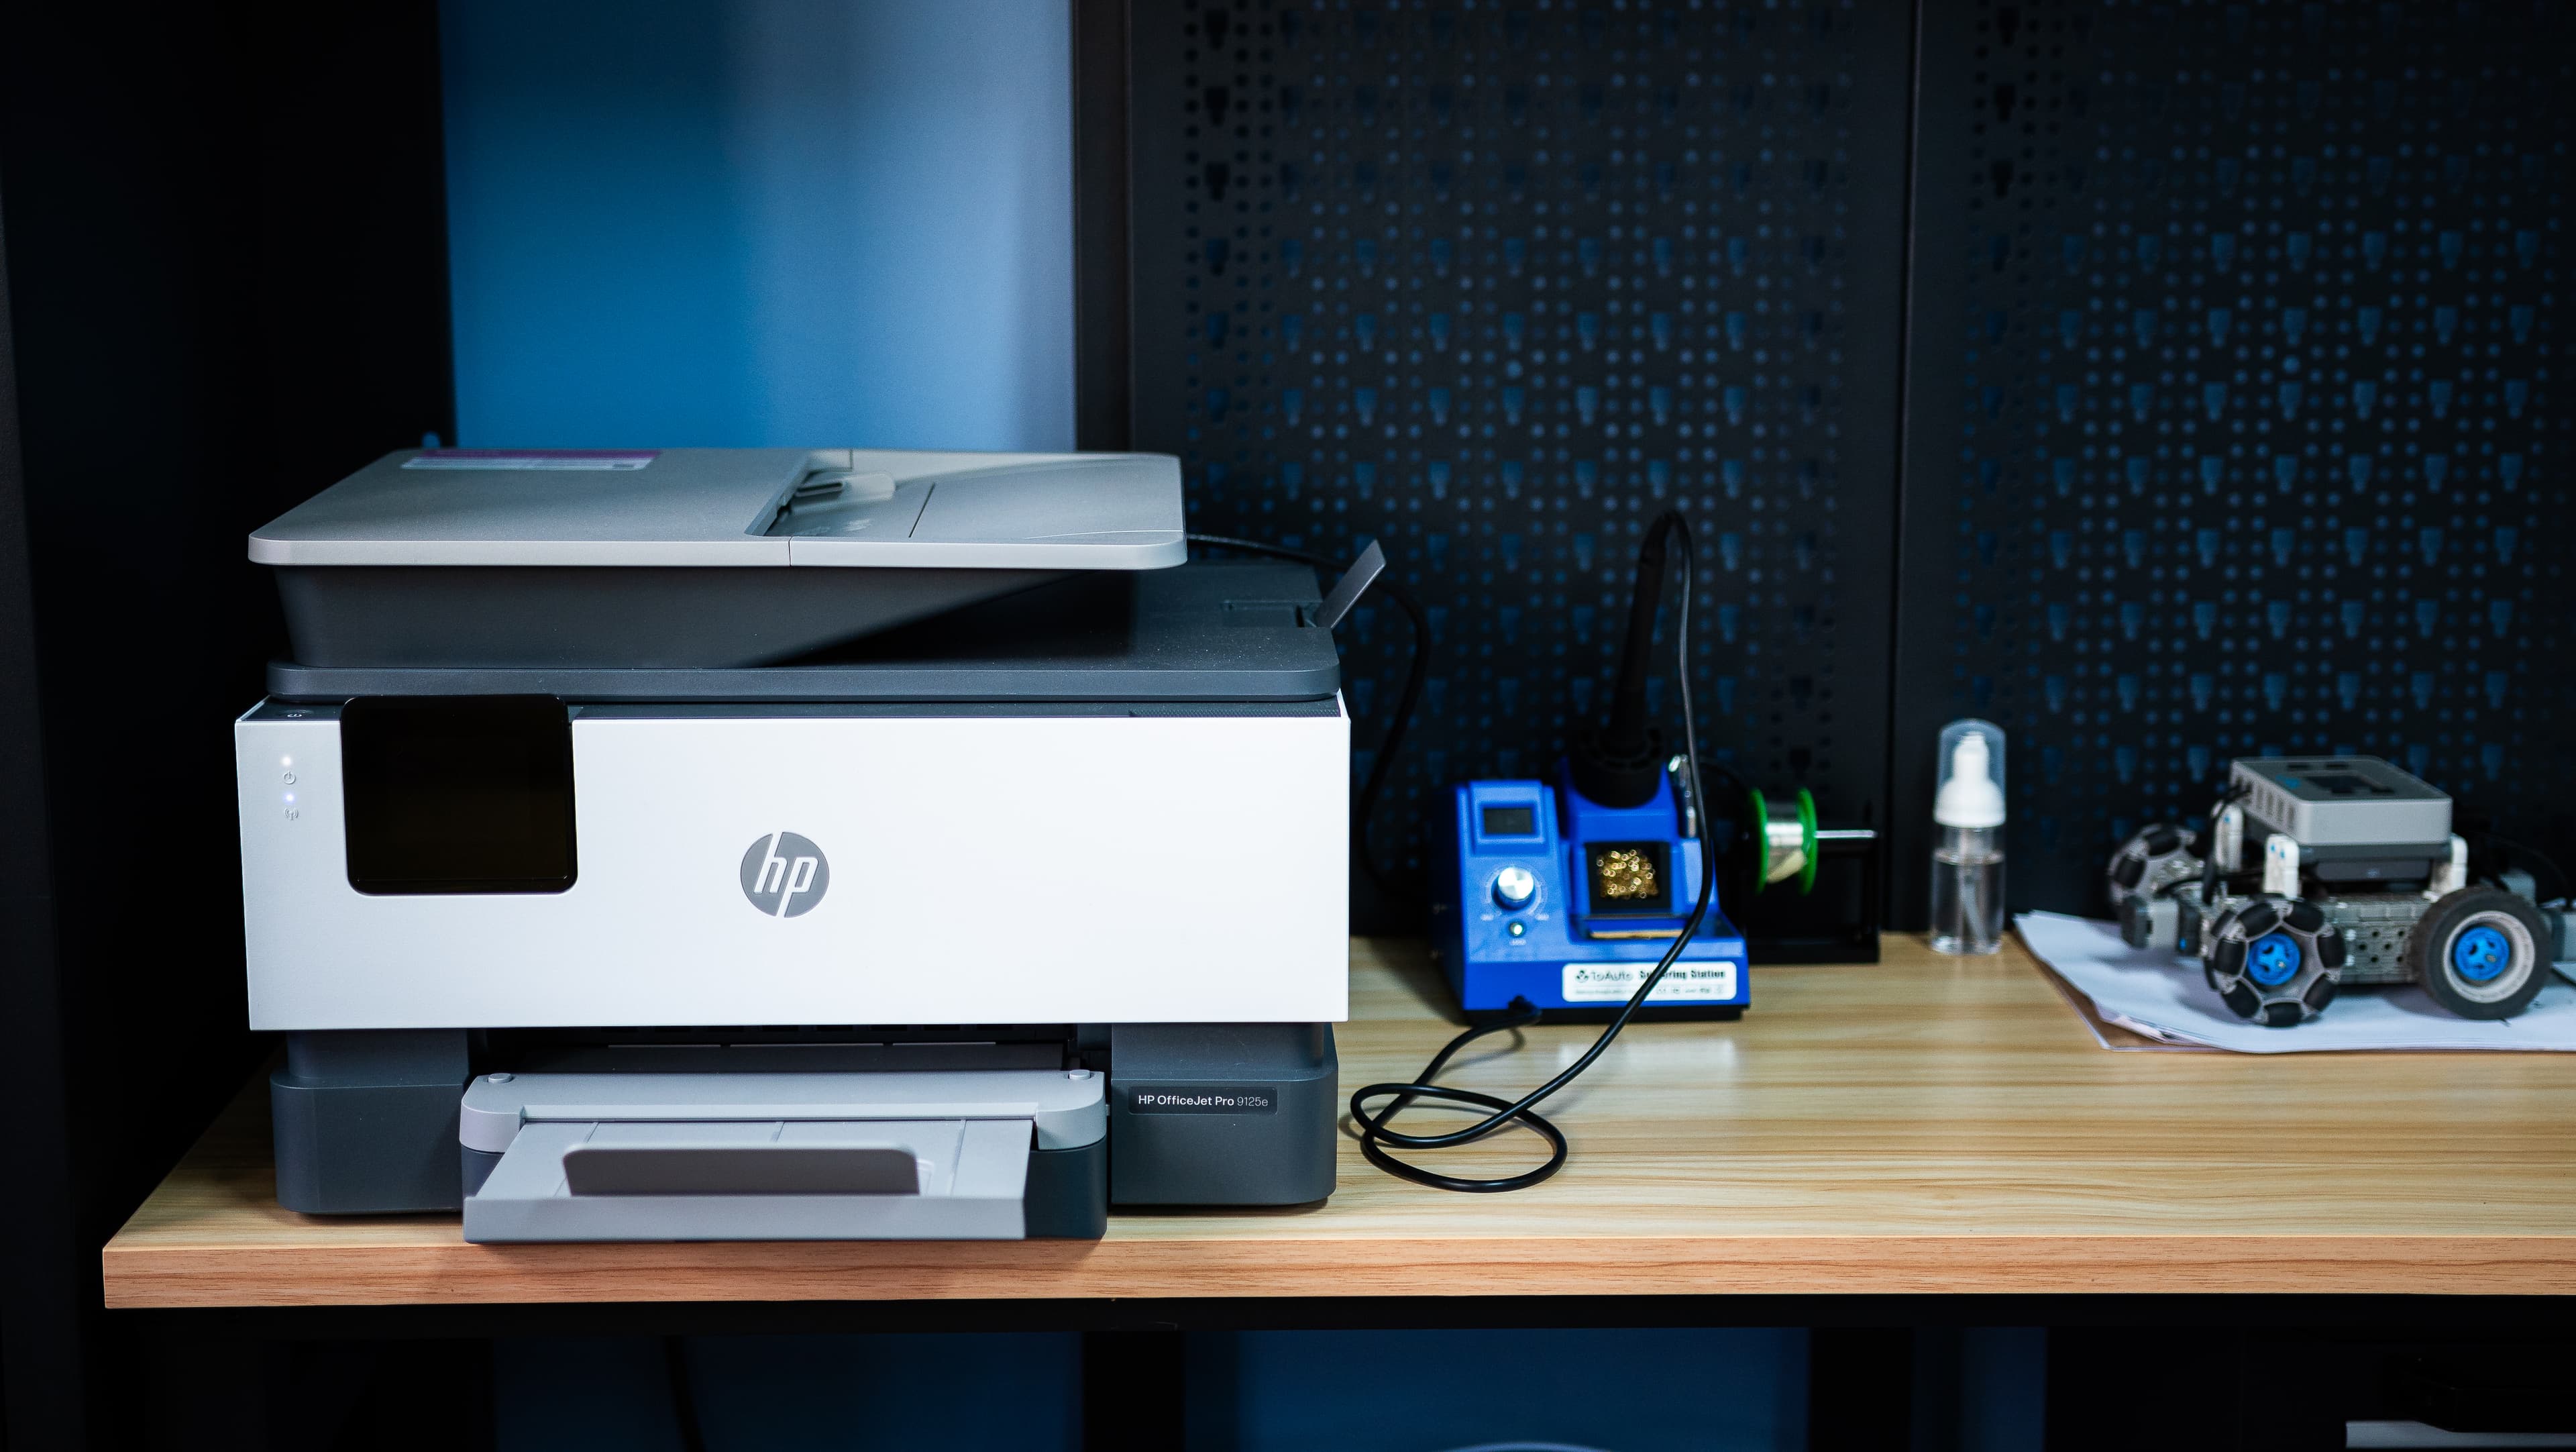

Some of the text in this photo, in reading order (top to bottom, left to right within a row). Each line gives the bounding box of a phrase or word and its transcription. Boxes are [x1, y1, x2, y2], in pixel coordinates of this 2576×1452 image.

[752, 831, 820, 918] hp
[1690, 969, 1726, 979] Station
[1138, 1094, 1269, 1107] HP OfficeJet Pro 9125e
